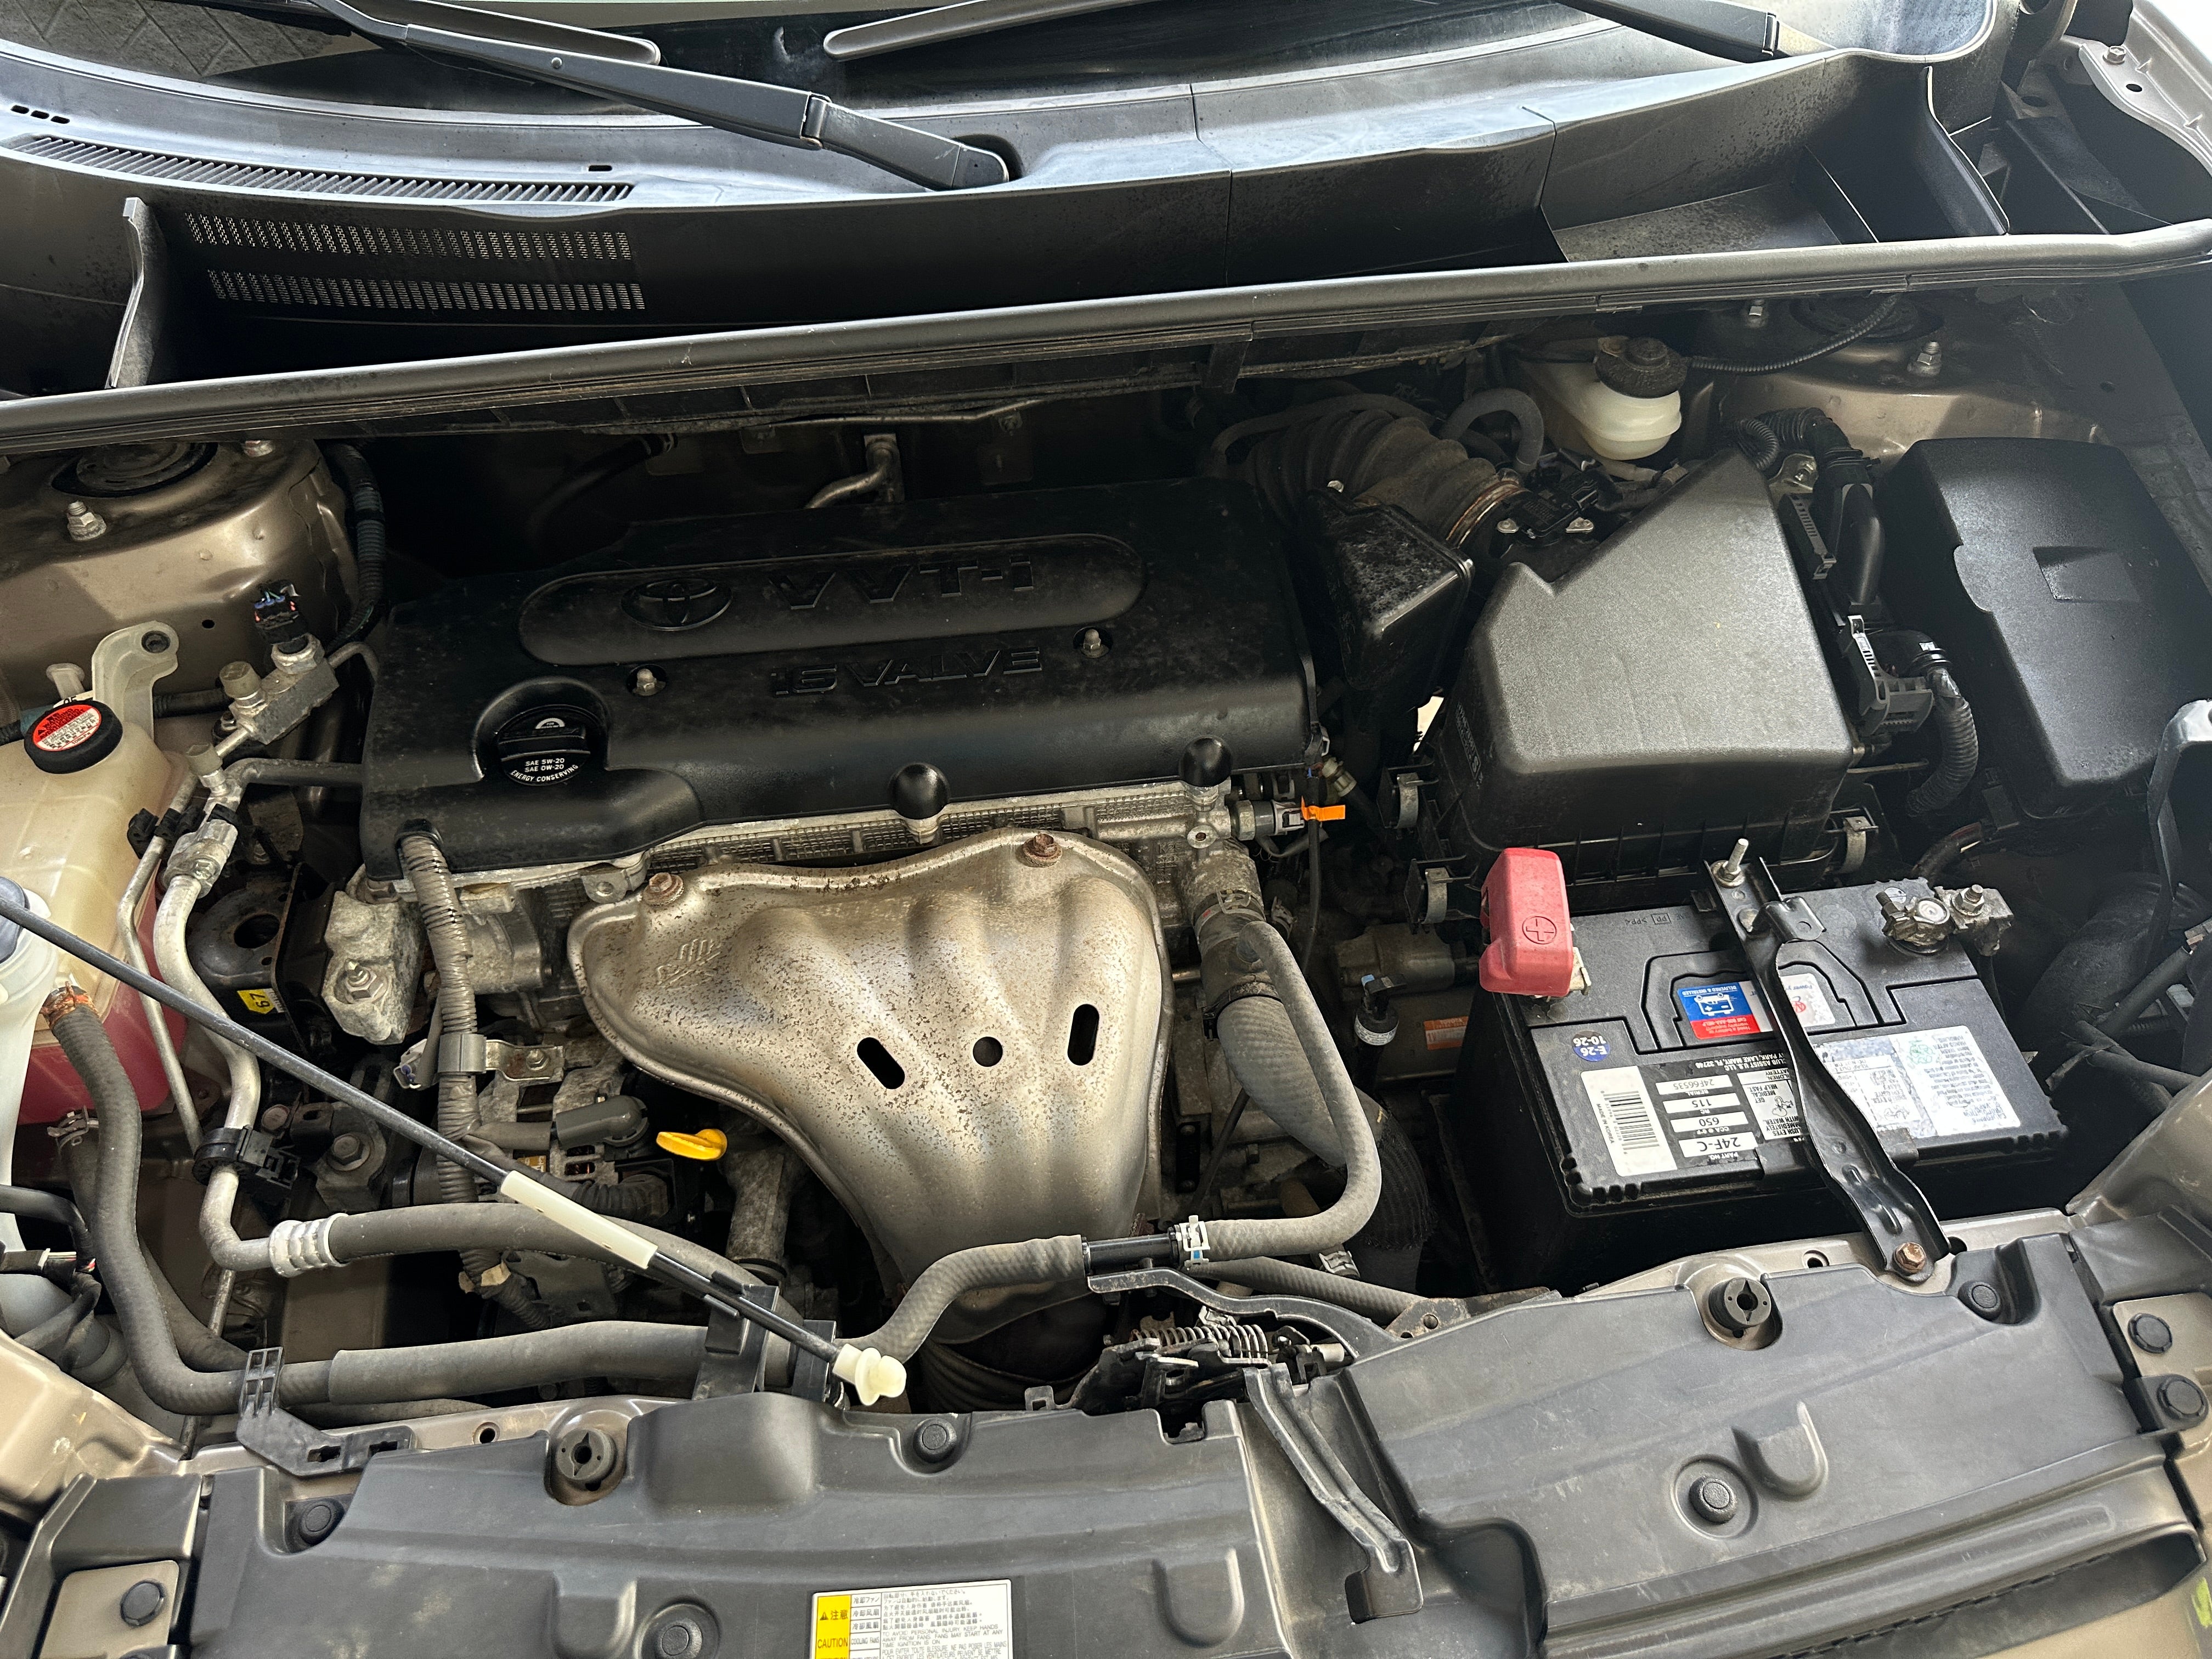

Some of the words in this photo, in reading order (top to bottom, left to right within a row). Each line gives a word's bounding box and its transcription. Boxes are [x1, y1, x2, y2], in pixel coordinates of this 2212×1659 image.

[769, 555, 1034, 609] VVT-i
[772, 664, 838, 697] 16
[845, 647, 1043, 688] VALVE
[510, 770, 534, 782] ENERGY
[536, 764, 579, 782] CONSERVING
[1572, 1034, 1606, 1047] 10-26
[1579, 1045, 1607, 1057] E-26
[1722, 1056, 1742, 1065] MARY,
[1749, 1059, 1770, 1068] ASSIST
[1673, 1079, 1714, 1090] 24F66535
[1691, 1098, 1711, 1107] 115
[1596, 1103, 1605, 1118] MADE
[1605, 1125, 1615, 1143] KOREA
[1698, 1116, 1719, 1126] 650
[1762, 1117, 1784, 1125] WATER.
[1765, 1121, 1799, 1131] MMEDIATELY
[1696, 1136, 1740, 1152] 24F-C
[830, 1609, 848, 1620] 注意
[817, 1637, 848, 1648] CAUTION
